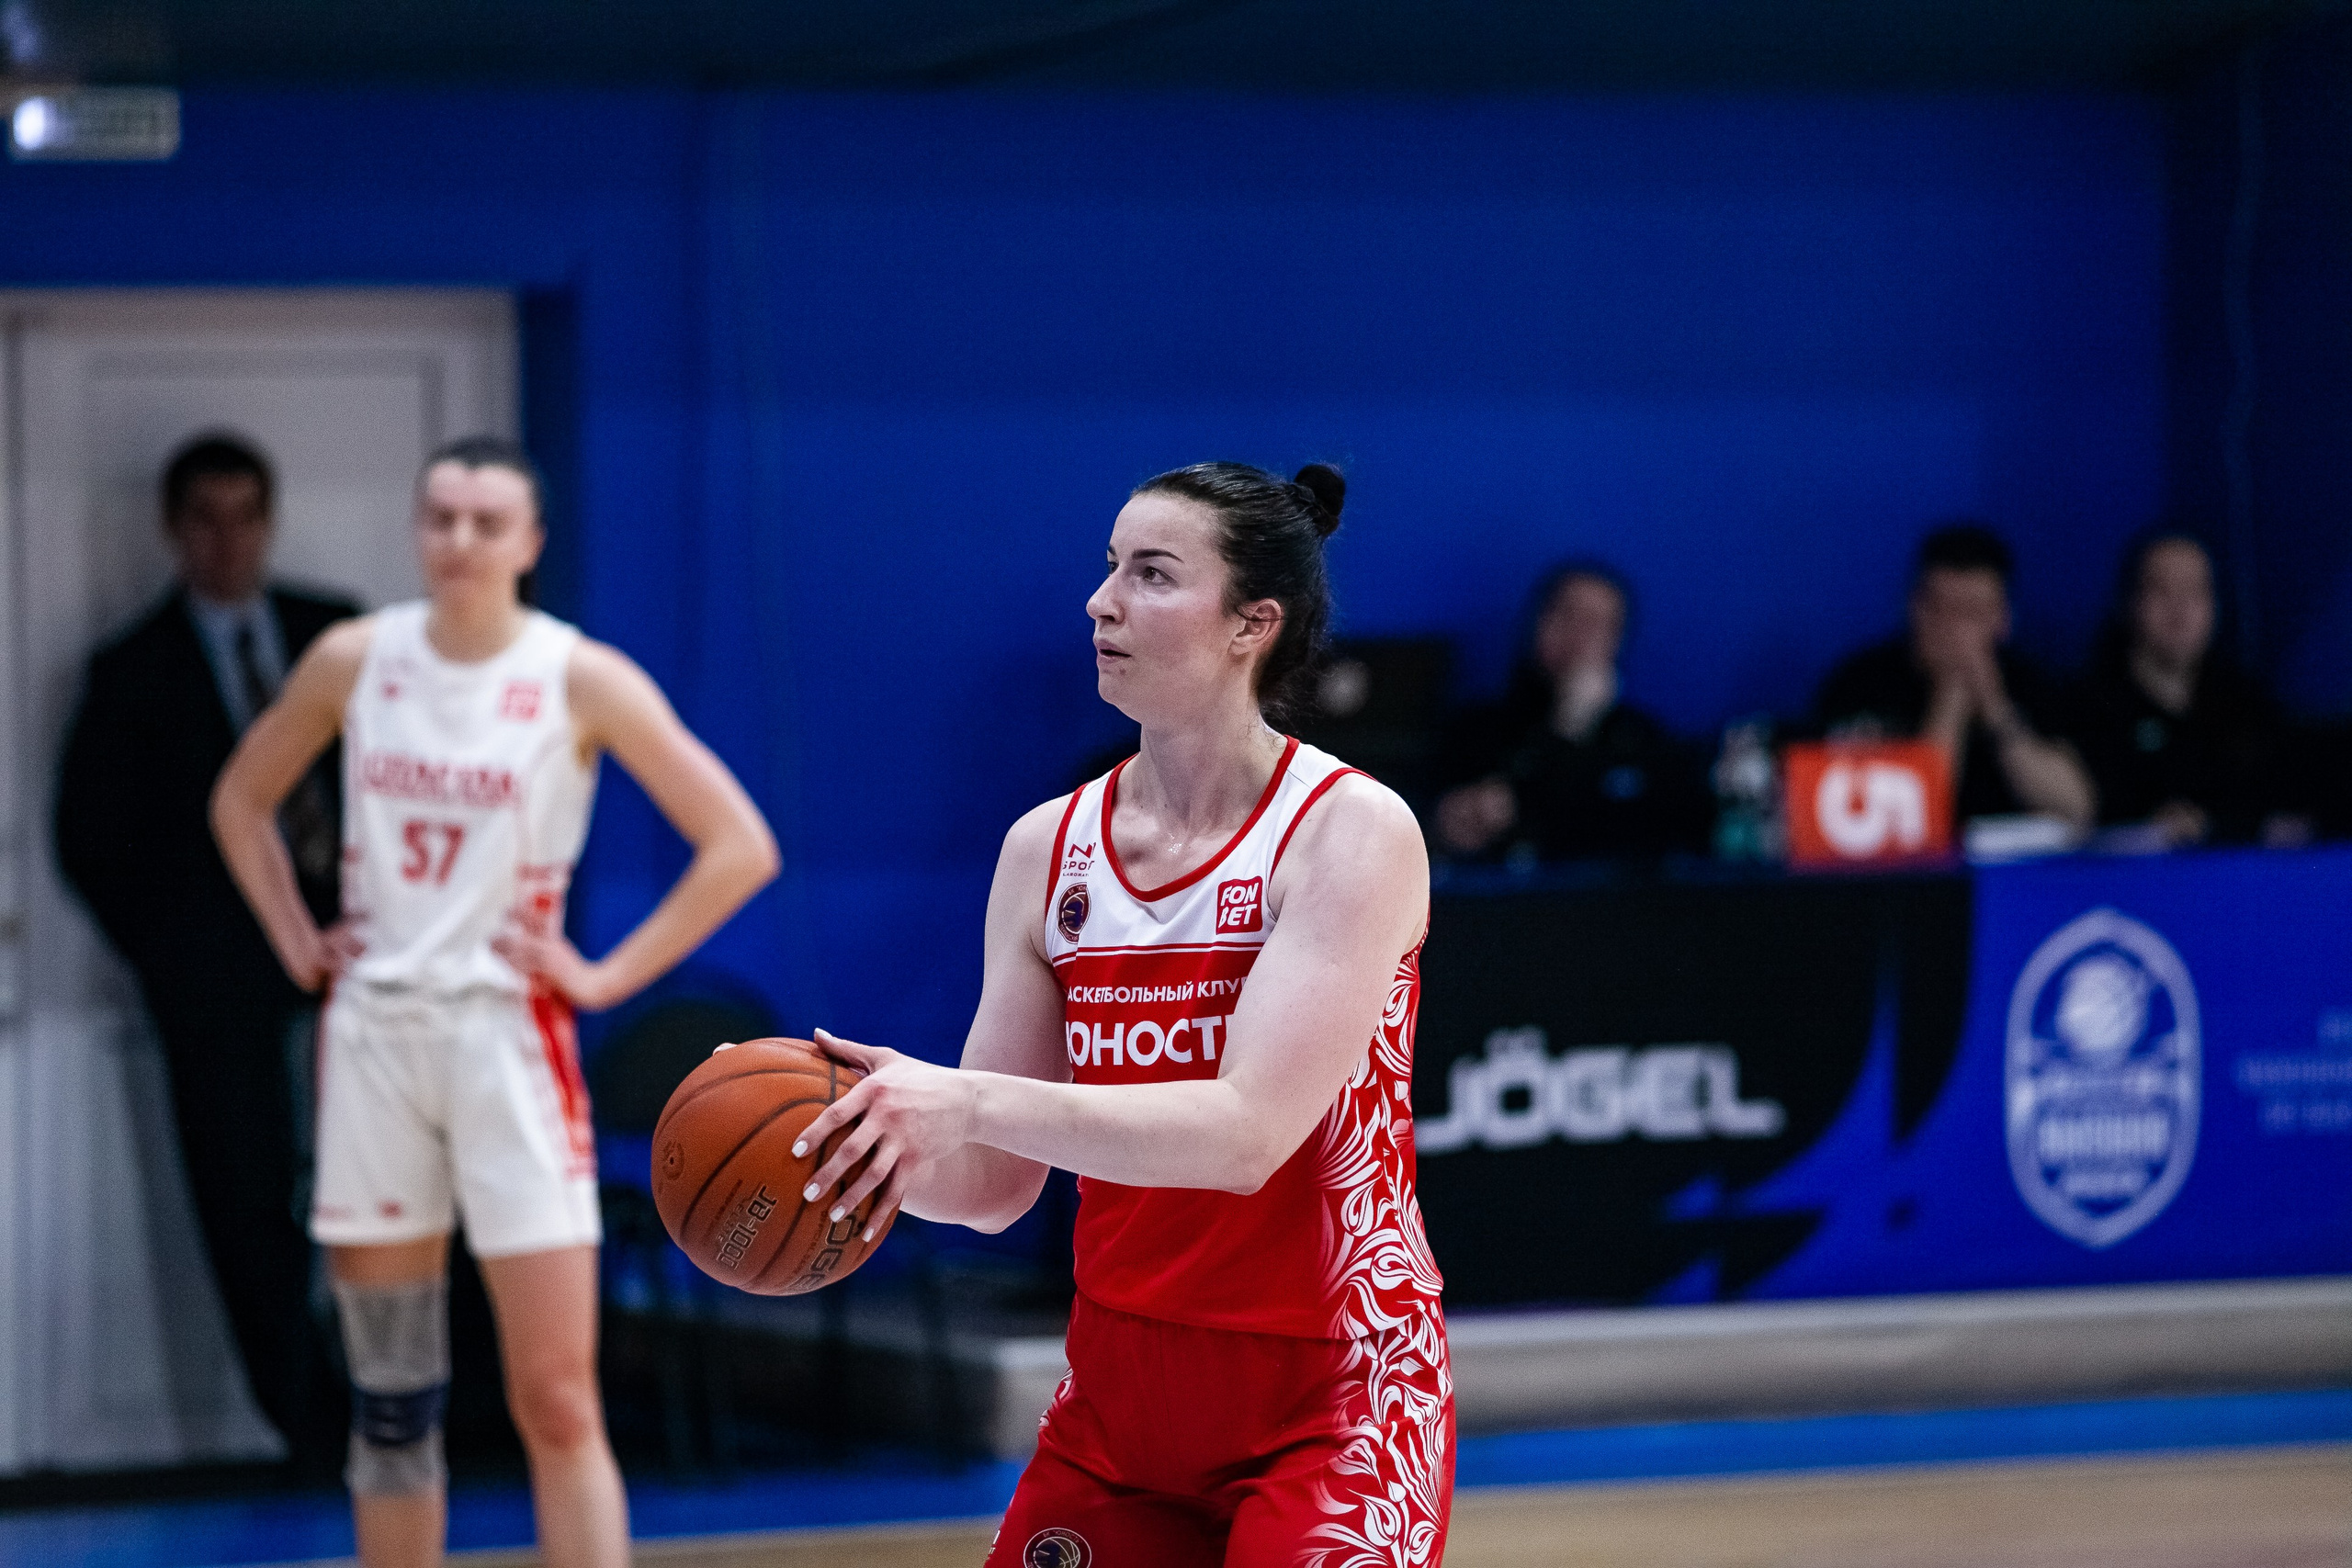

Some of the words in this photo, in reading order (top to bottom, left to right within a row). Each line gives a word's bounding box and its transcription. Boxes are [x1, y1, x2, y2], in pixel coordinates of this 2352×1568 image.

[1815, 760, 1926, 858] 5
[401, 819, 465, 886] 57
[1220, 882, 1259, 907] FON
[1217, 904, 1257, 929] BET
[1067, 981, 1193, 1003] АСКЕТБОЛЬНЫЙ
